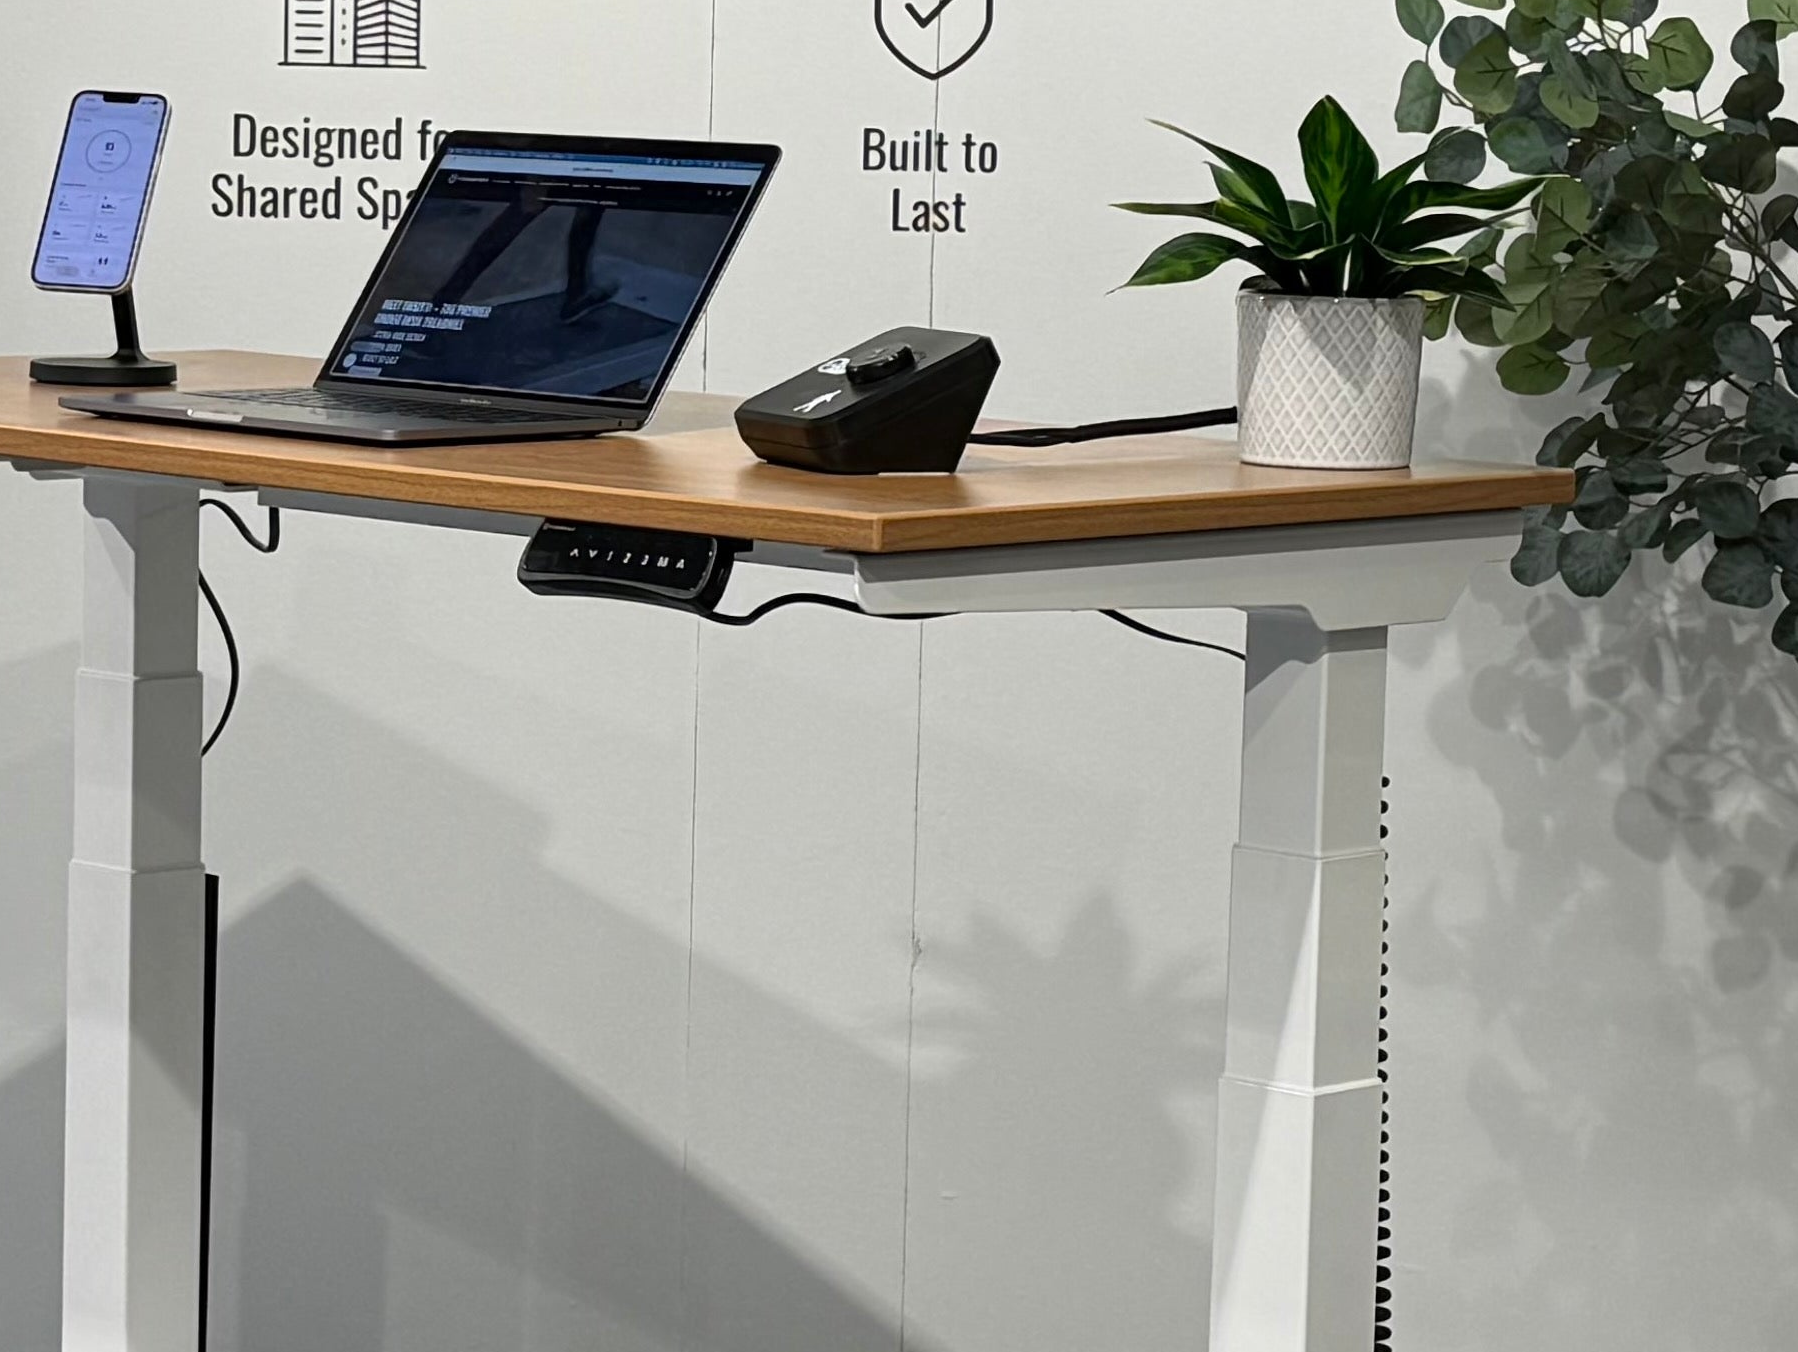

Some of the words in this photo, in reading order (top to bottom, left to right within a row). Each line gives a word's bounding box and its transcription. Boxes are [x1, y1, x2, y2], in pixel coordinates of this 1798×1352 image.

[233, 113, 403, 168] Designed
[862, 127, 949, 173] Built
[961, 133, 998, 173] to
[211, 173, 342, 220] Shared
[892, 188, 966, 233] Last
